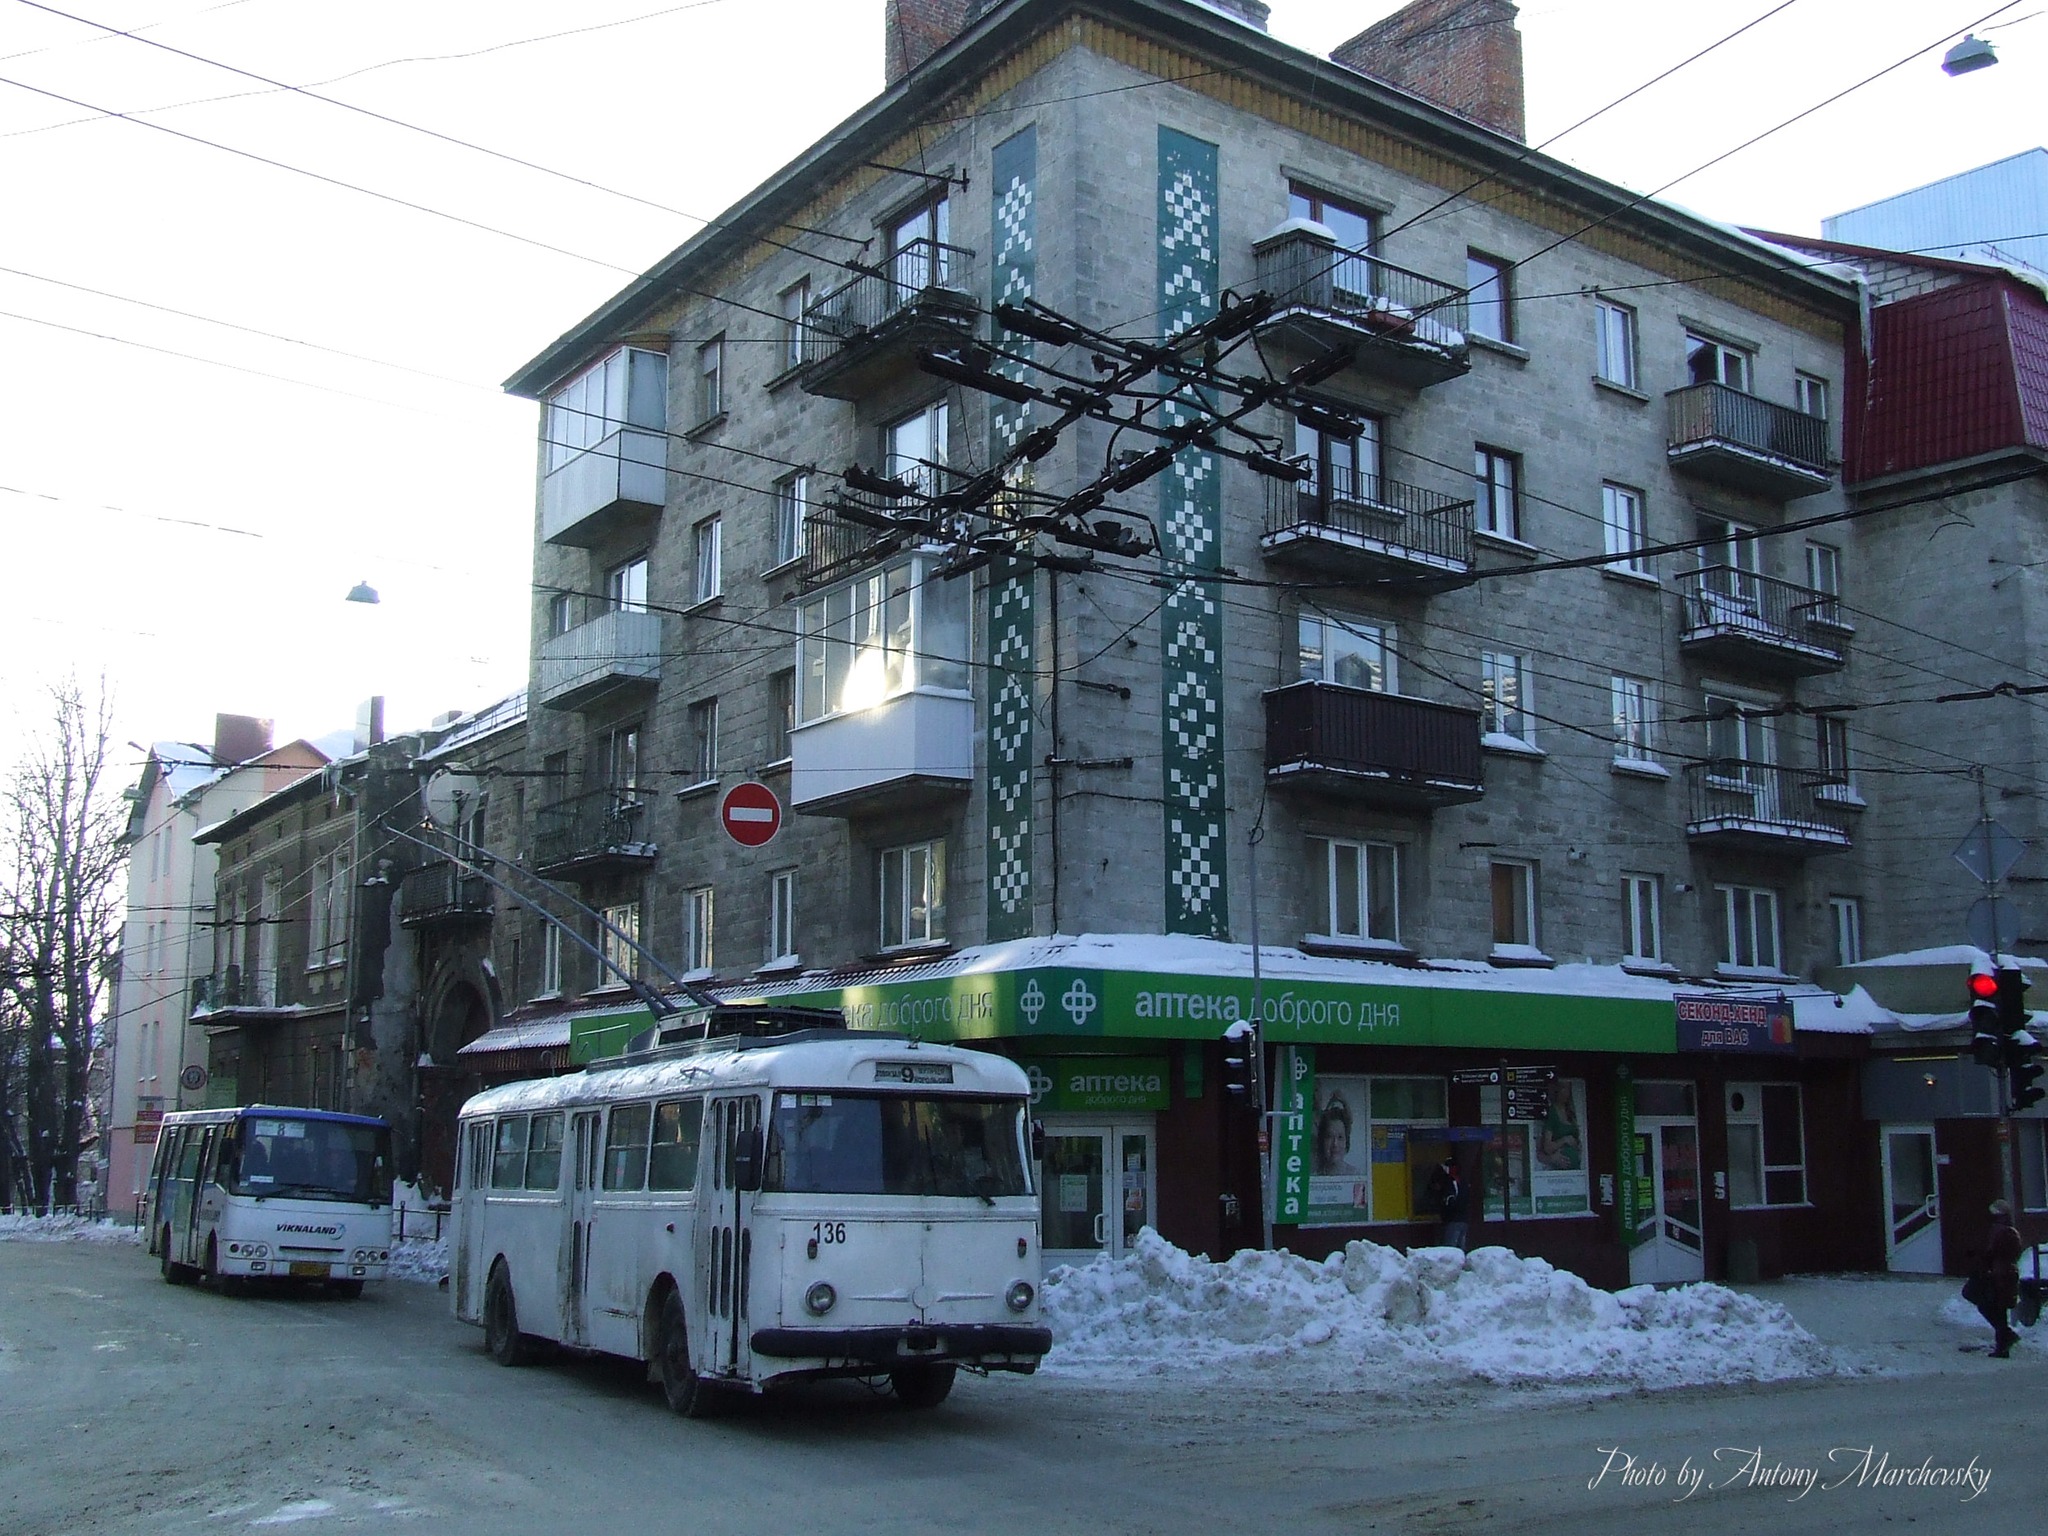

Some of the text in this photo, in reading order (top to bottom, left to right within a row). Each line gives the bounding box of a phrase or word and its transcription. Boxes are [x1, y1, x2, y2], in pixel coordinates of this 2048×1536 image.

[878, 994, 954, 1032] доброго
[958, 992, 993, 1026] дня
[1135, 991, 1240, 1020] аптека
[1358, 1002, 1400, 1032] дня
[1678, 1000, 1768, 1027] СЕКОНД-ХЕНД
[1701, 1028, 1750, 1047] для ВАС
[901, 1065, 914, 1083] 9
[1070, 1074, 1161, 1093] аптека
[1085, 1094, 1126, 1105] доброго
[277, 1122, 286, 1136] 8
[1284, 1092, 1304, 1216] аптека
[1623, 1179, 1633, 1230] аптека
[276, 1223, 337, 1236] VIKNALAND
[813, 1222, 846, 1244] 136
